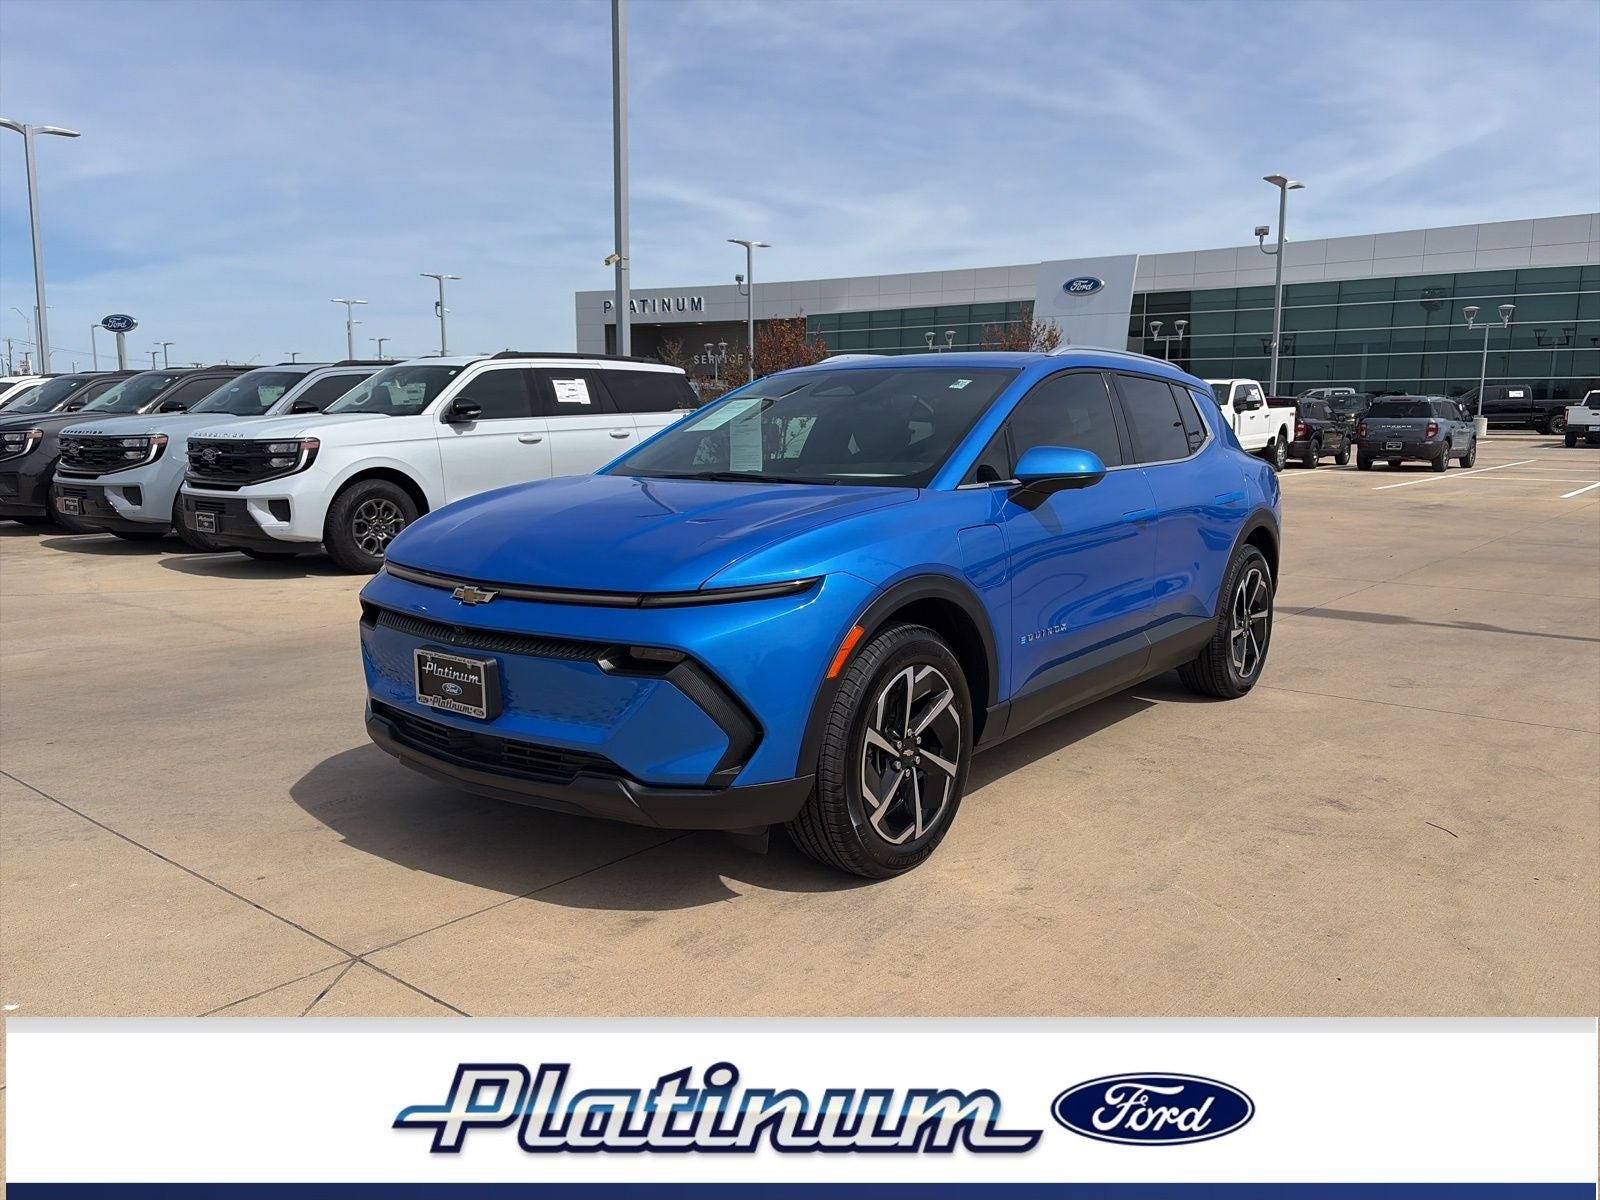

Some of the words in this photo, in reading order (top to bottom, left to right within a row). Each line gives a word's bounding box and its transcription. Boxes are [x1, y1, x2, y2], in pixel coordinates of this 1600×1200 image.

[1070, 280, 1094, 291] Ford
[603, 296, 704, 314] PATINUM
[1020, 623, 1067, 645] EQUINOX
[421, 661, 482, 685] Platinum
[431, 695, 473, 713] Platinum
